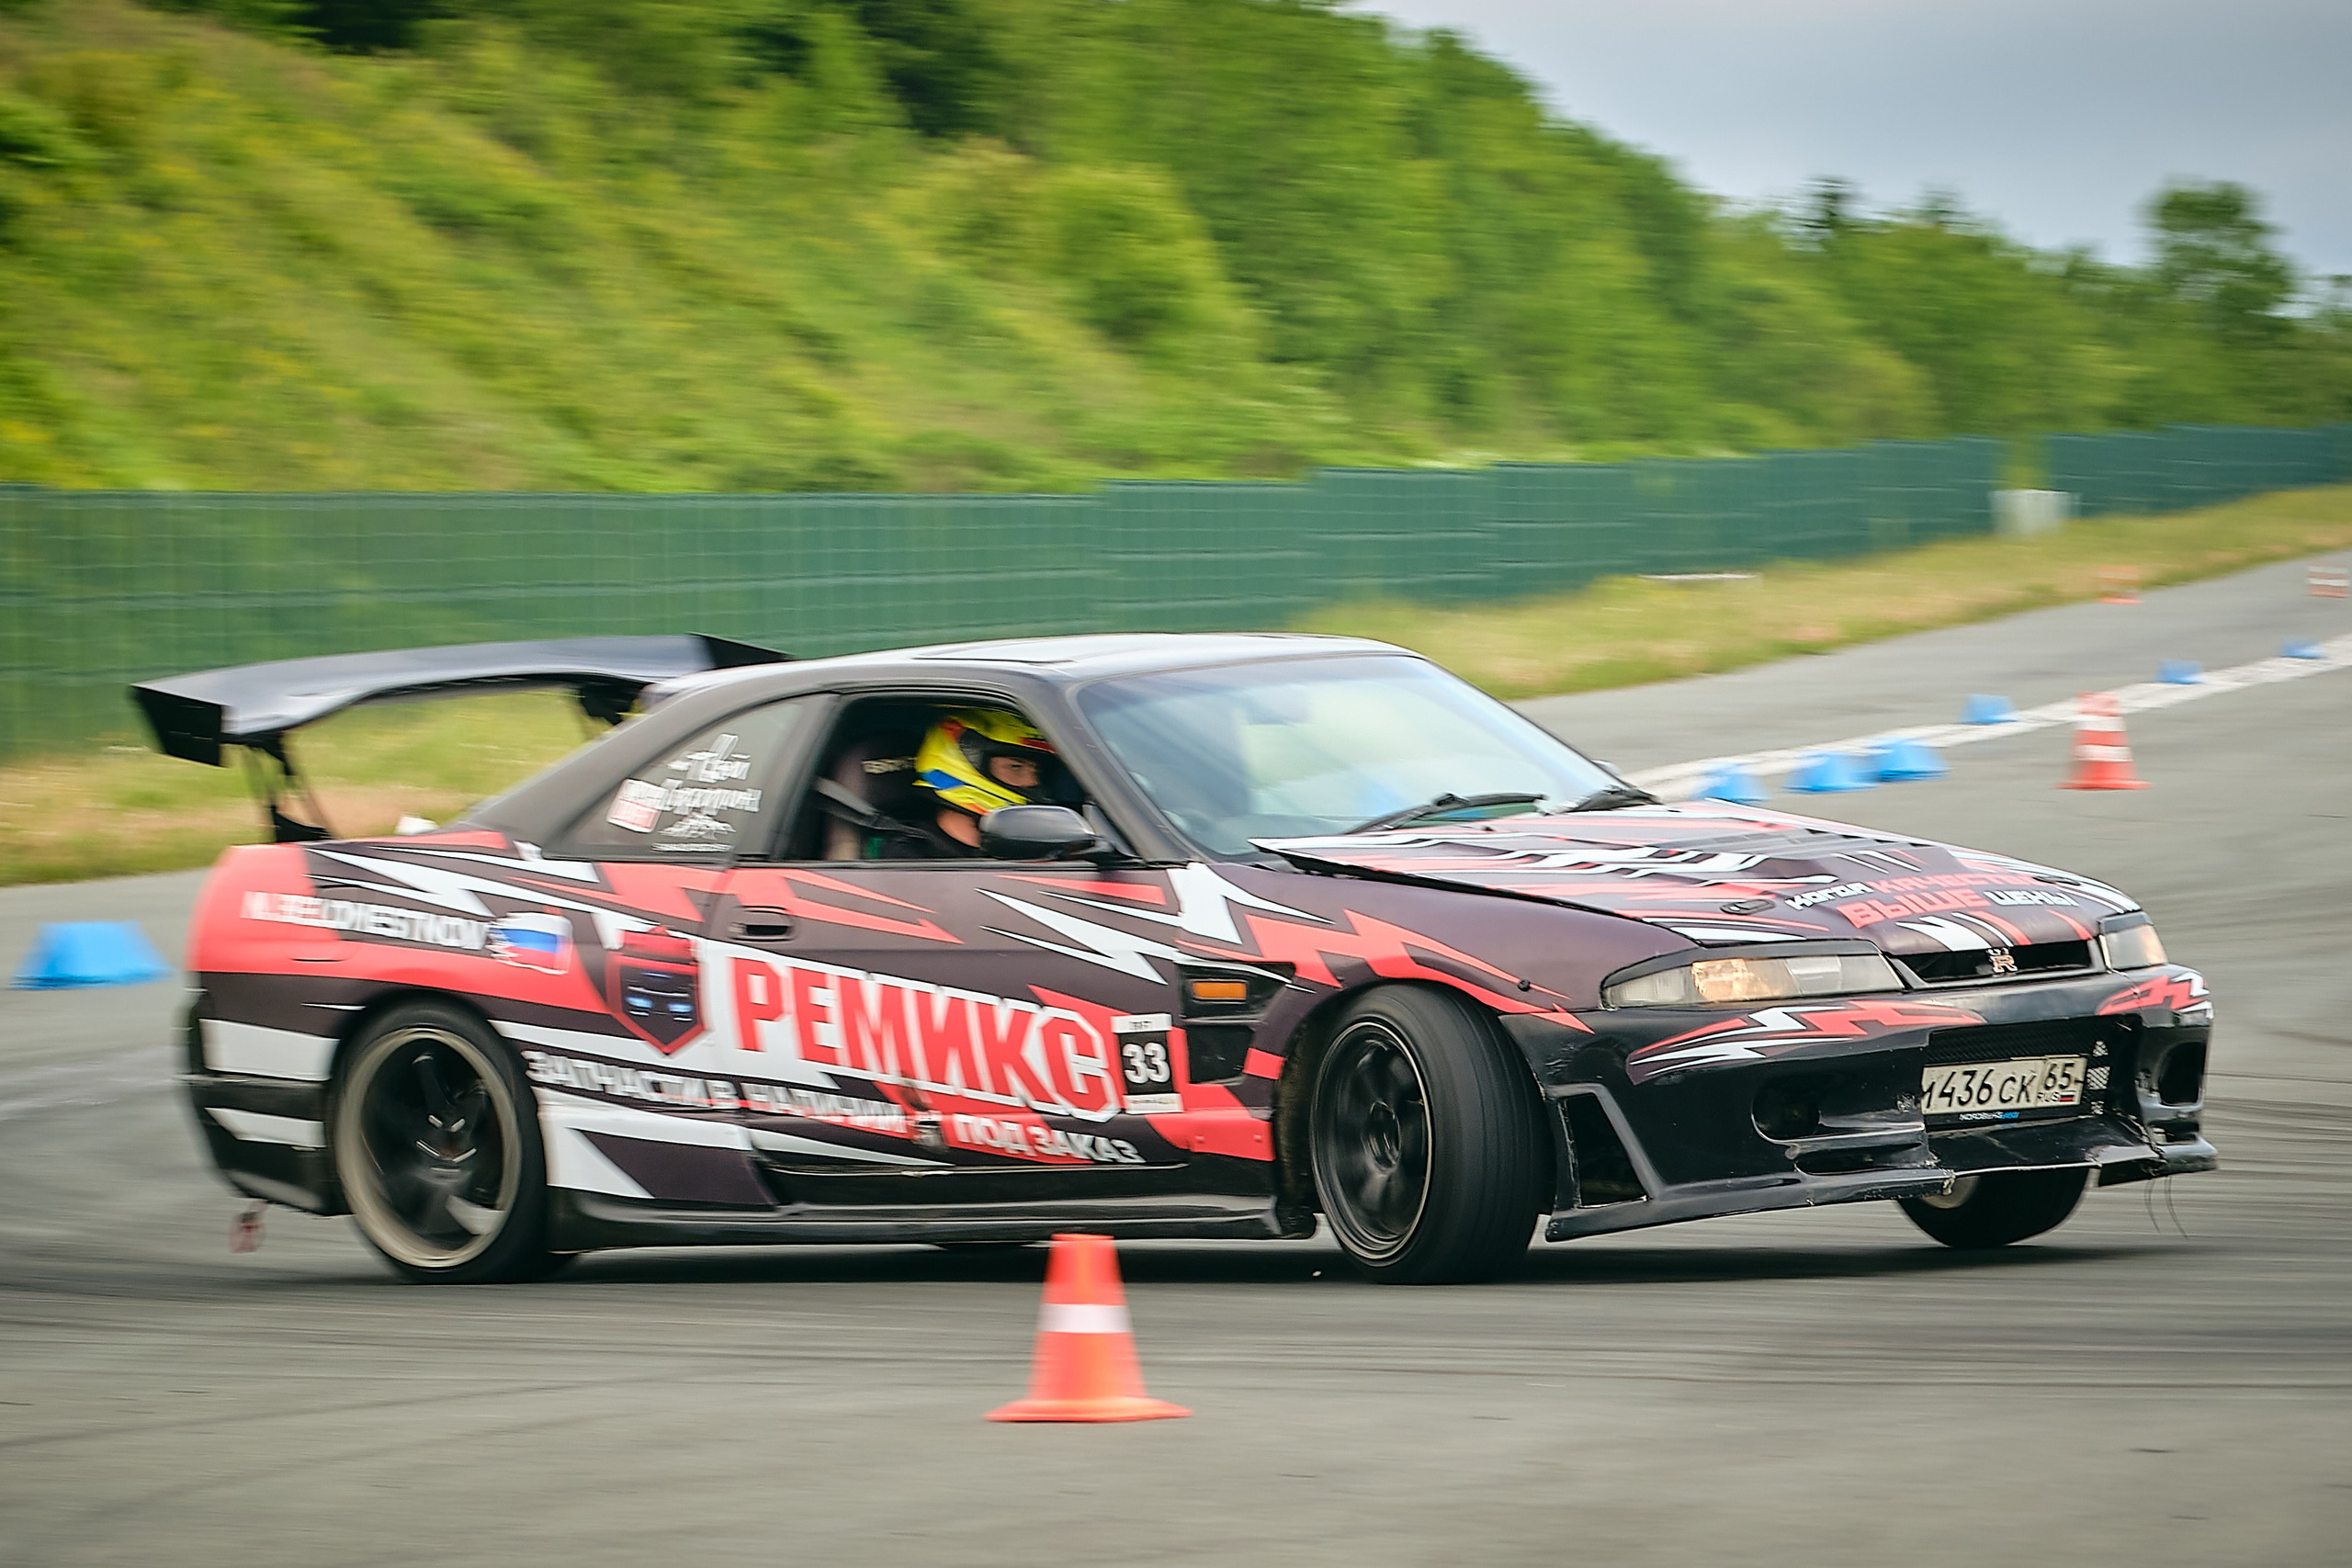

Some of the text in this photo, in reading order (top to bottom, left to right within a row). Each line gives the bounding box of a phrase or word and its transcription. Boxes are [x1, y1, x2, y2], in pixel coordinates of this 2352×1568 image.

[1785, 881, 1874, 910] КОГДА
[1837, 888, 2080, 929] ВЫШЕ ЦЕНЫ
[726, 956, 1110, 1112] РЕМИКС
[1122, 1042, 1170, 1084] 33
[2043, 1062, 2076, 1090] 65
[2037, 1090, 2061, 1103] RUS
[952, 1112, 1036, 1157] ПОД
[1026, 1125, 1148, 1164] ЗАКАЗ
